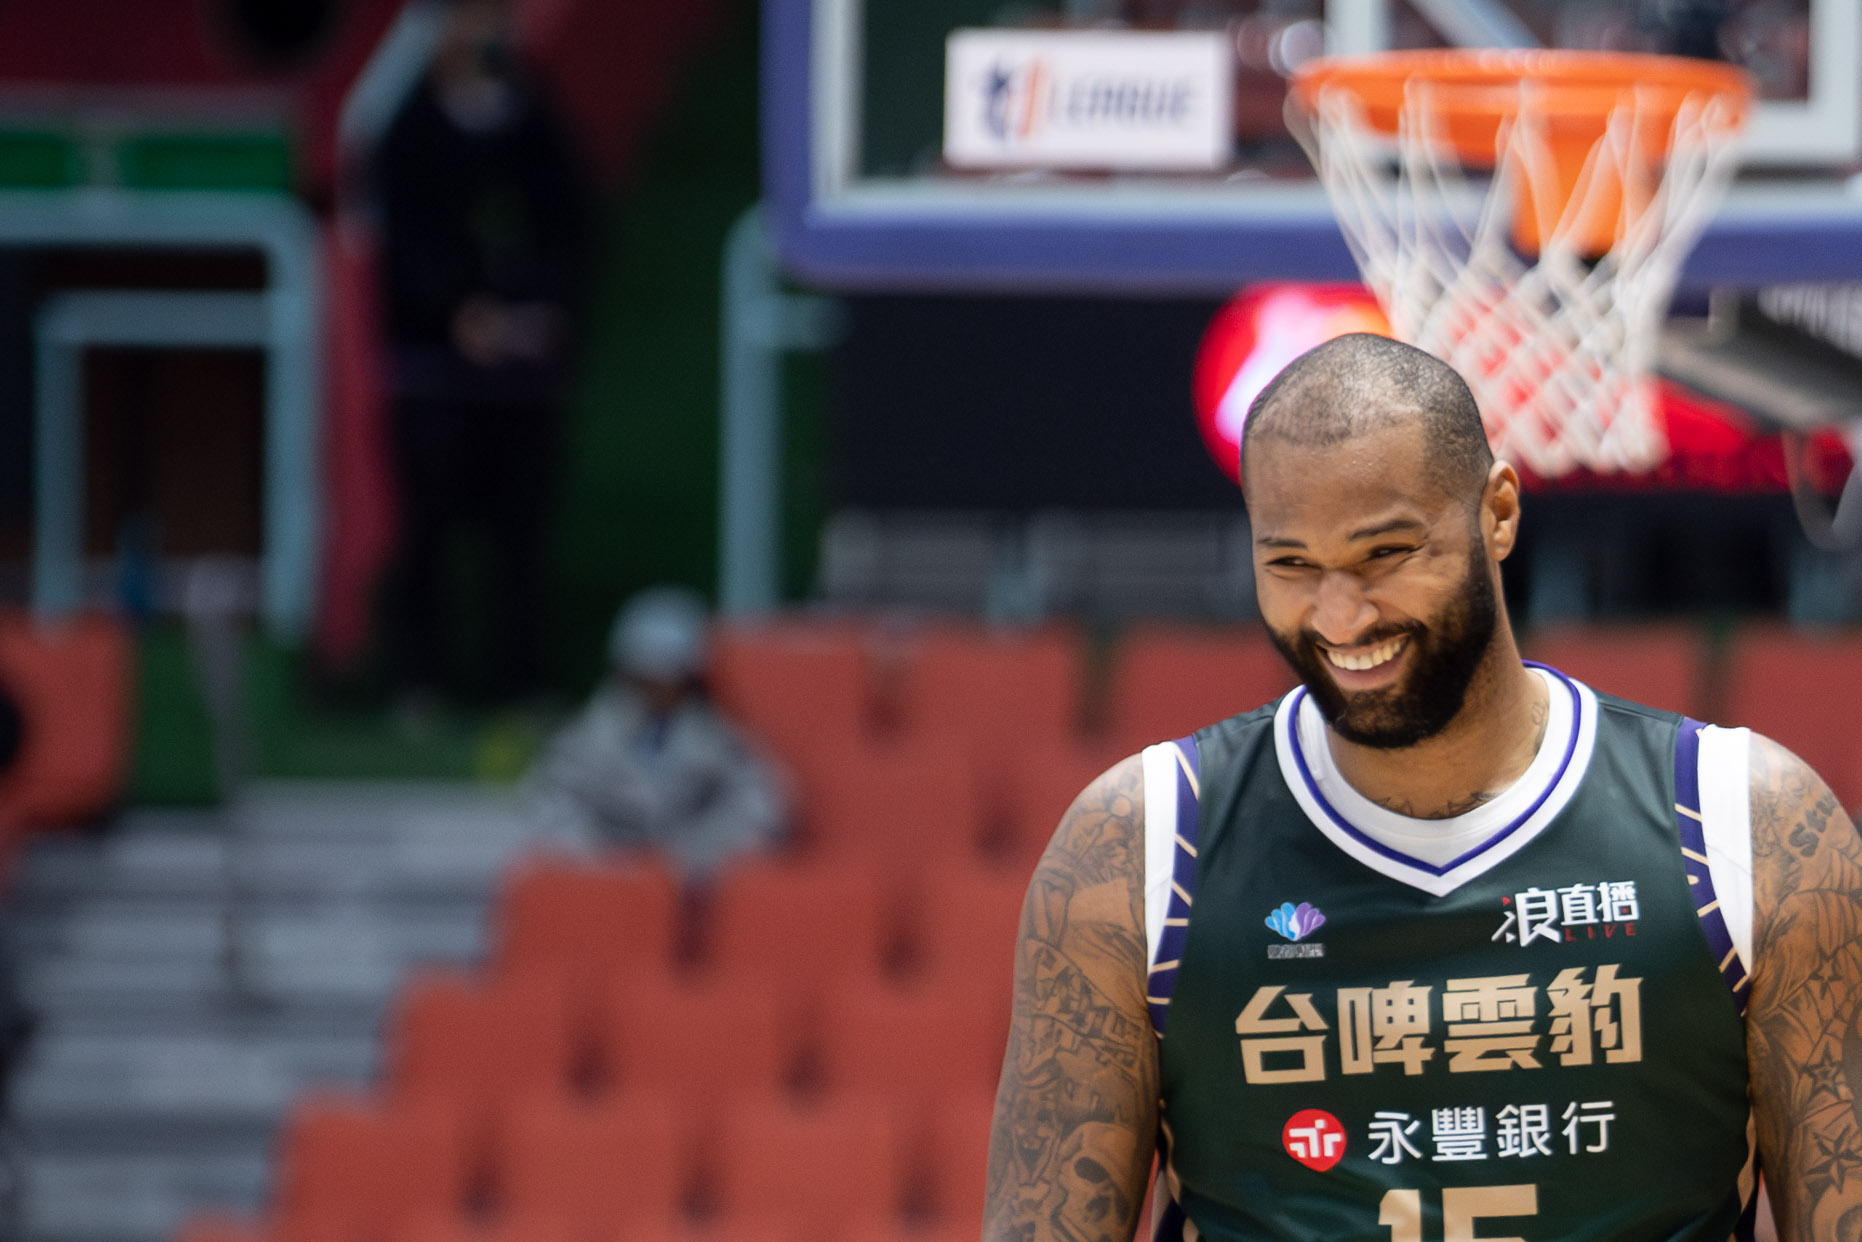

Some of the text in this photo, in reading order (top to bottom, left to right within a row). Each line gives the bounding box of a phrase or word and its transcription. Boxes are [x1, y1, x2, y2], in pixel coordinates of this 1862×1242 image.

[1491, 880, 1640, 947] 浪直播
[1564, 921, 1637, 942] LIVE
[1235, 964, 1643, 1084] 台啤雲豹
[1367, 1101, 1616, 1165] 永豐銀行
